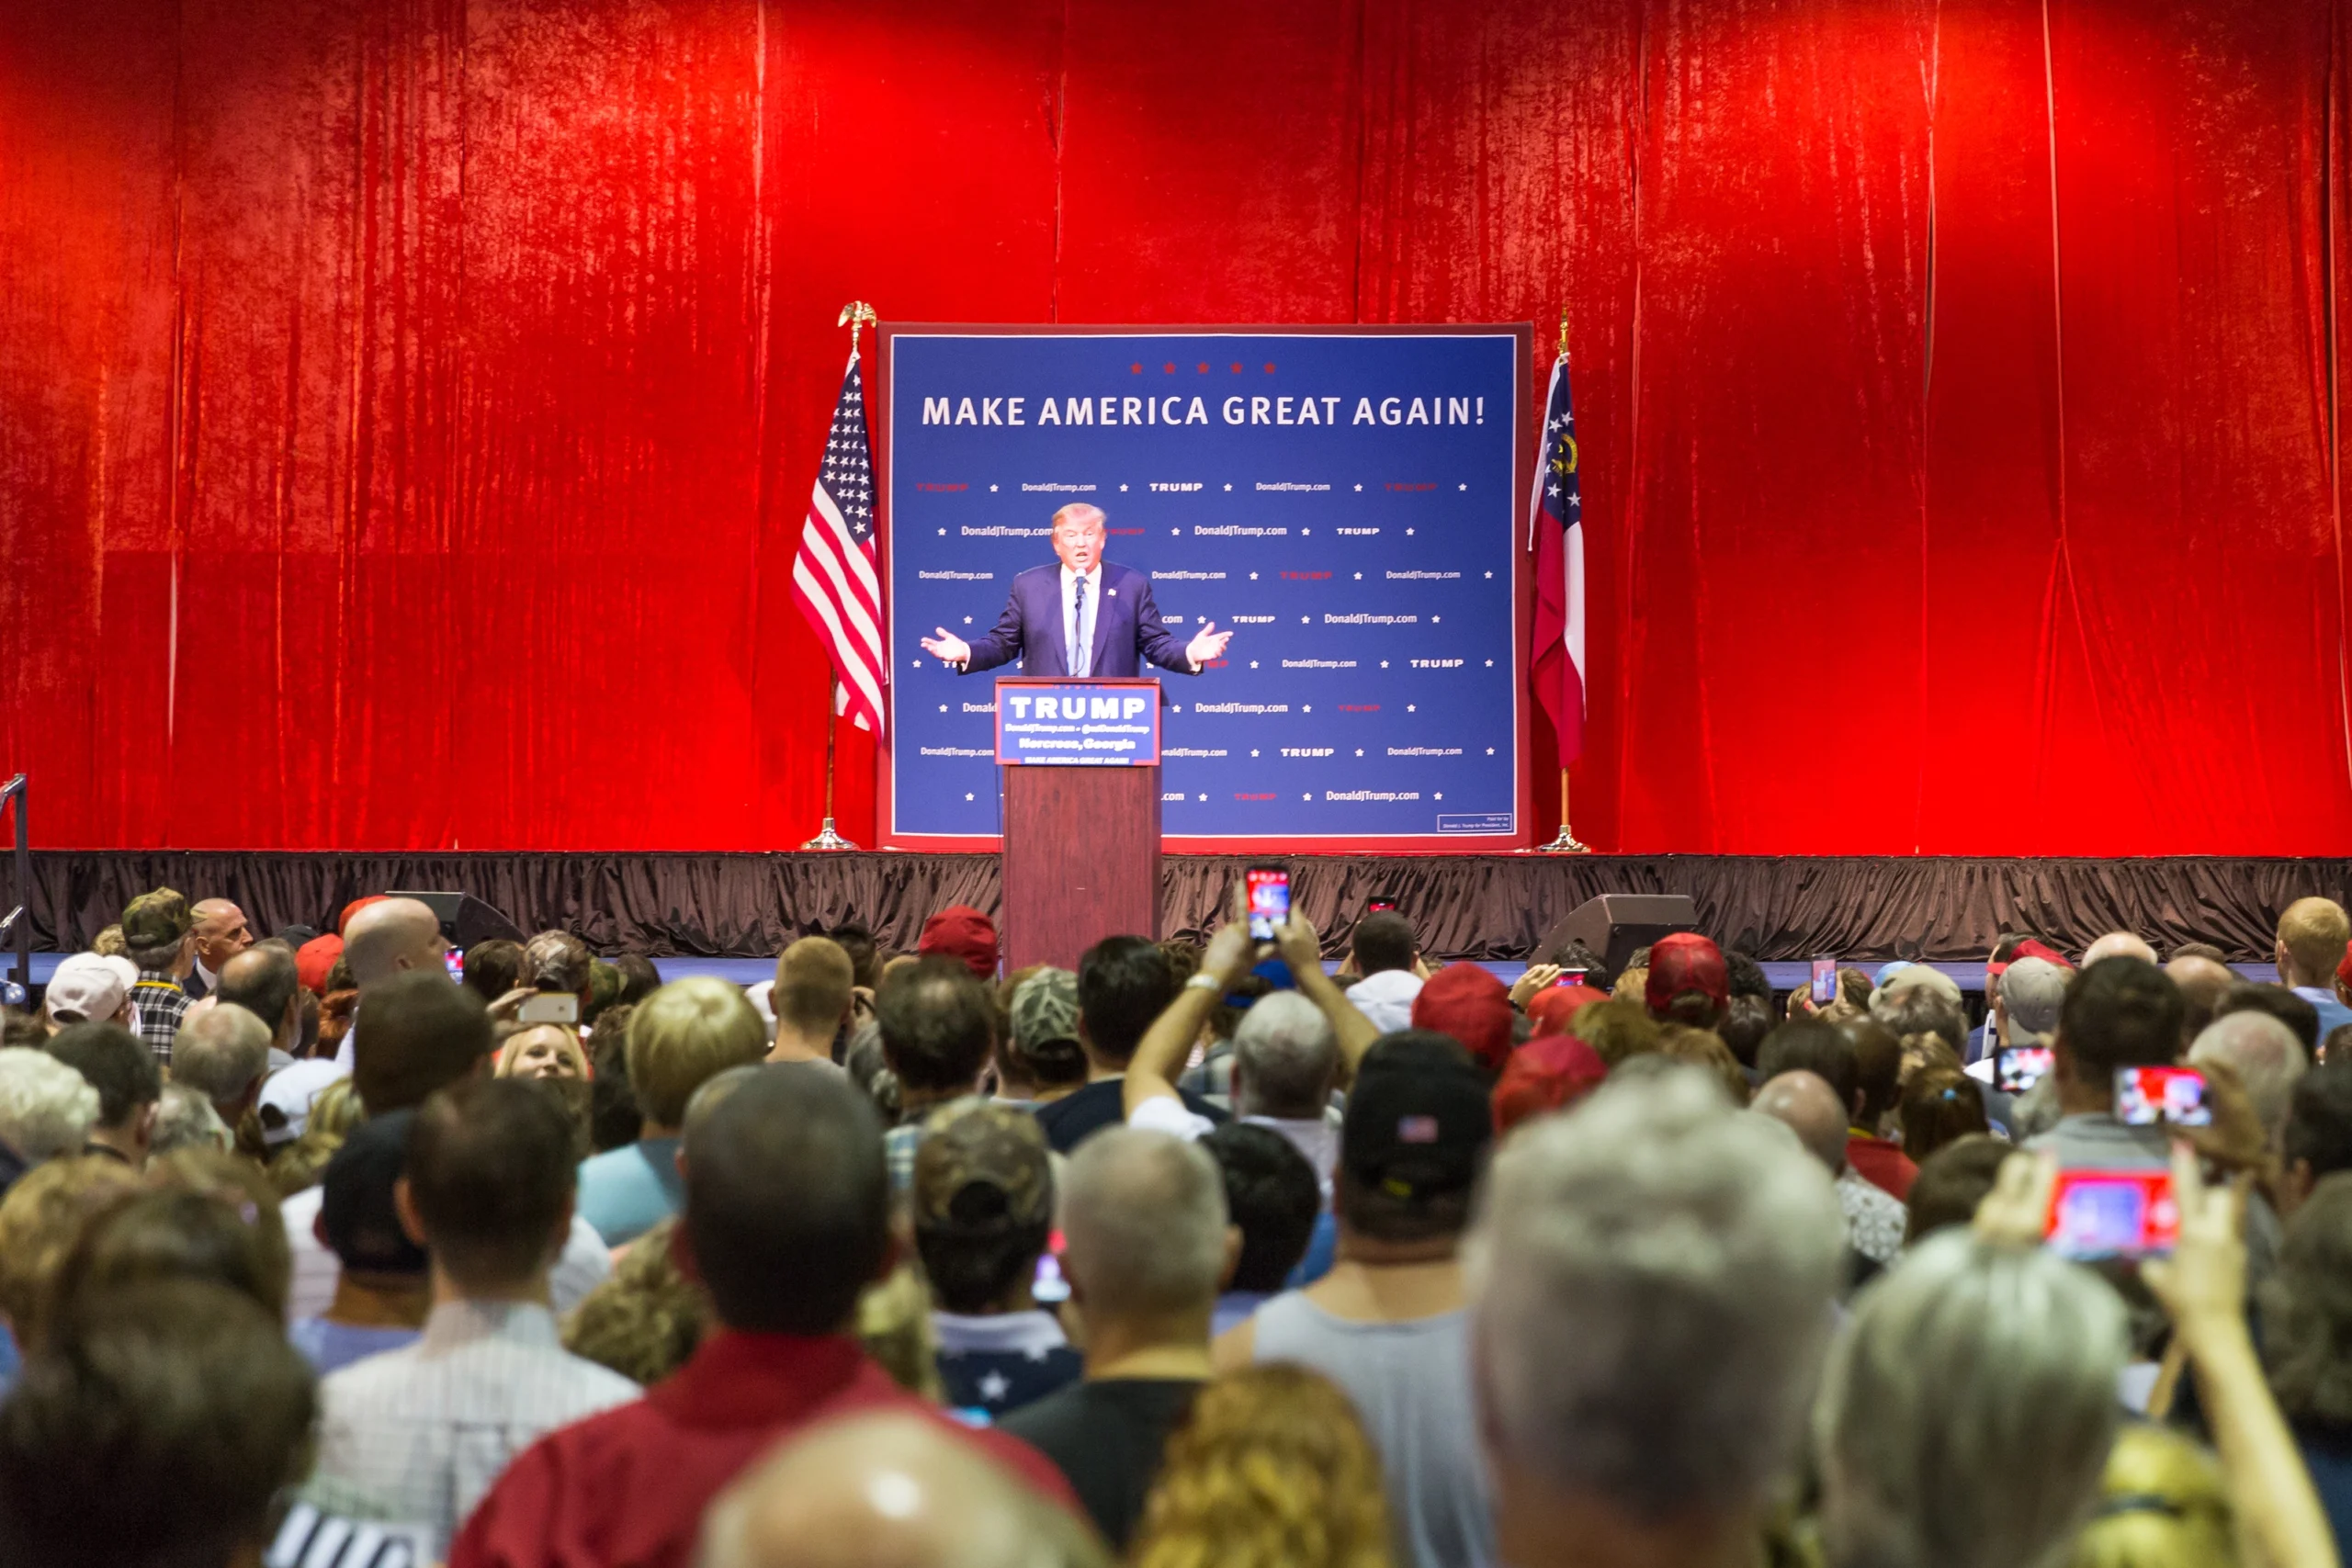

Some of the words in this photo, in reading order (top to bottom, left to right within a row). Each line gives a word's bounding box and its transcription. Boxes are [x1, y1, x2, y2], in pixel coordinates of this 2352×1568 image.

[922, 398, 1024, 425] MAKE
[1038, 397, 1208, 425] AMERICA
[1223, 397, 1340, 424] GREAT
[1352, 397, 1483, 425] AGAIN!
[917, 483, 968, 491] TRUMP
[1022, 482, 1096, 493] DonaldJTrump.com
[1149, 483, 1203, 491] TRUMP
[1256, 481, 1330, 492] DonaldJTrump.com
[1385, 483, 1437, 491] TRUMP
[962, 525, 1054, 538] DonaldJTrump.com
[1194, 525, 1287, 536] DonaldJTrump.com
[919, 570, 993, 581] DonaldJTrump.com
[1152, 570, 1226, 581] DonaldJTrump.com
[1280, 571, 1331, 580] TRUMP
[1386, 570, 1460, 581] DonaldJTrump.com
[1325, 614, 1417, 625] DonaldJTrump.com
[1283, 659, 1356, 670] DonaldJTrump.com
[1410, 660, 1464, 668] TRUMP
[1010, 696, 1146, 719] TRUMP
[1195, 703, 1288, 714] DonaldJTrump.com
[1019, 738, 1083, 750] Norcross,
[1083, 739, 1136, 751] Georgia
[921, 746, 994, 758] DonaldJTrump.com
[1161, 747, 1227, 759] naldJTrump.com
[1281, 749, 1334, 757] TRUMP
[1387, 747, 1462, 757] DonaldJTrump.com
[1327, 791, 1419, 802] DonaldJTrump.com
